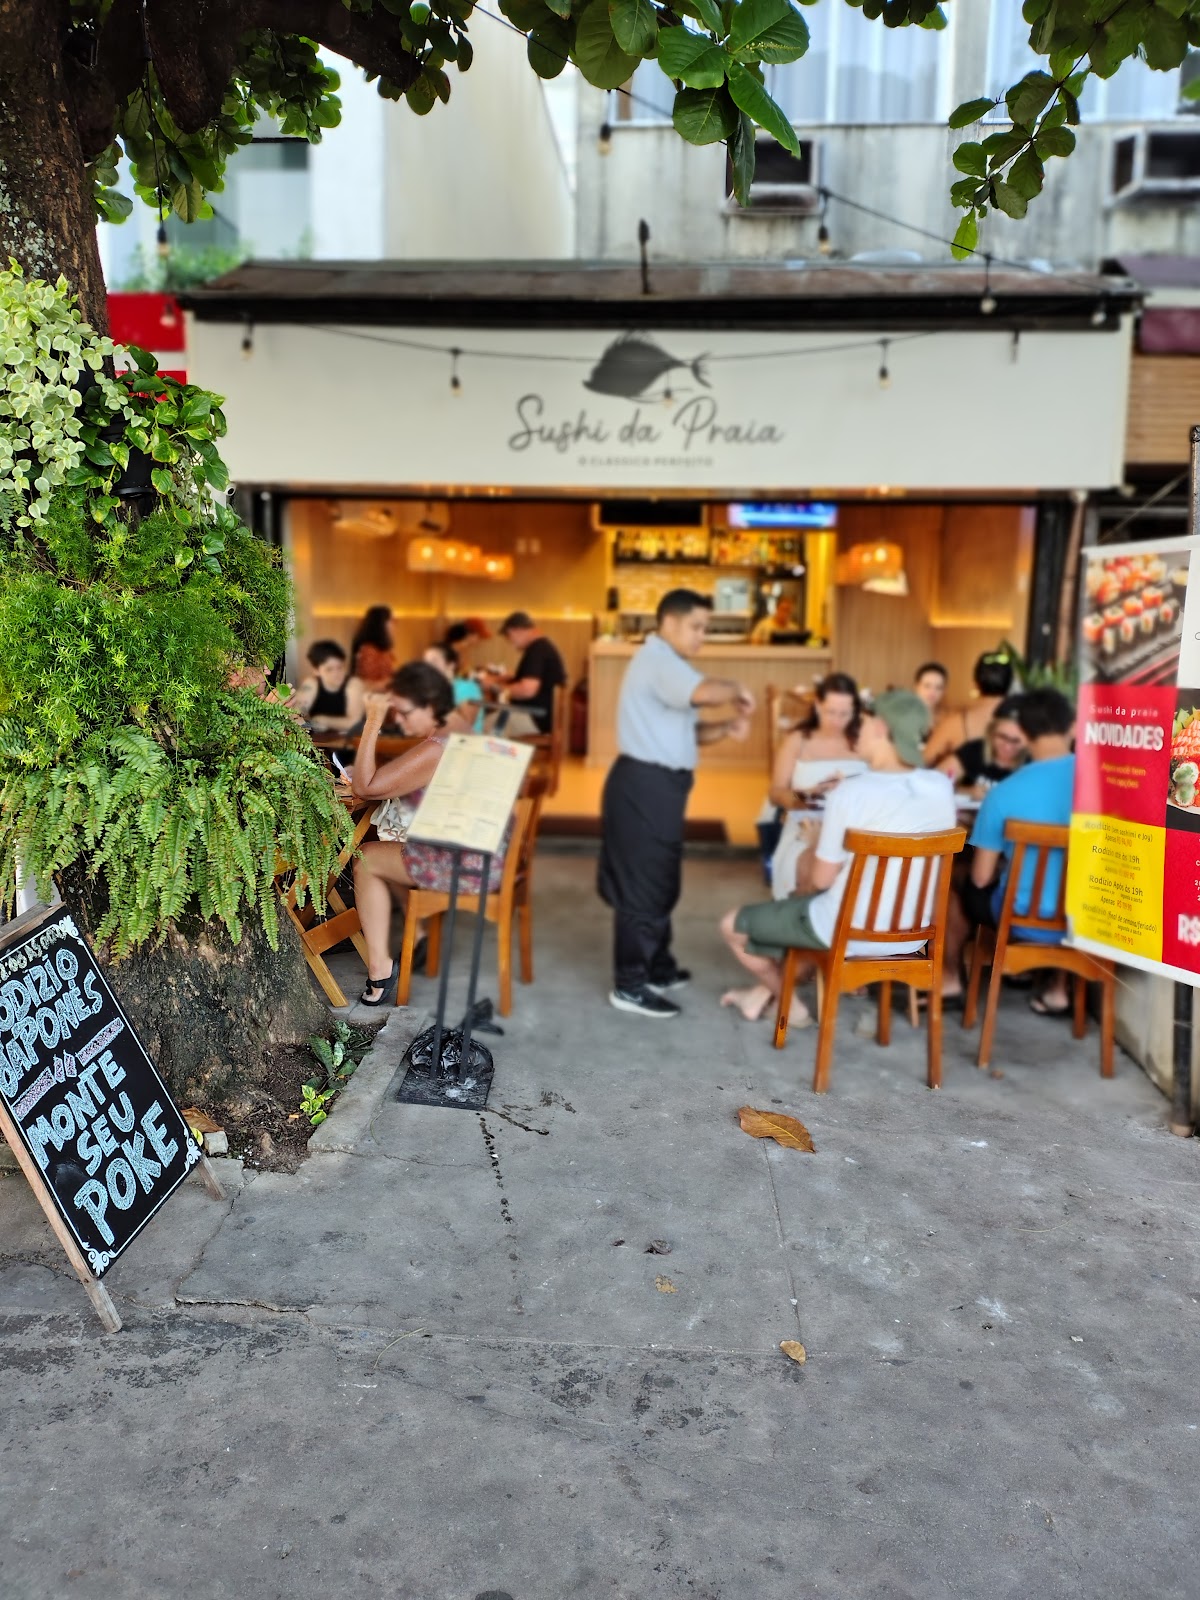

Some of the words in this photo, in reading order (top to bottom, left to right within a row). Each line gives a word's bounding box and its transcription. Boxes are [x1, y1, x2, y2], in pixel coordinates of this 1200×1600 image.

[509, 394, 609, 453] Sushi
[618, 408, 662, 447] da
[672, 395, 785, 451] Praia
[1089, 704, 1113, 715] Sushi
[1115, 705, 1126, 716] da
[1130, 708, 1159, 718] praia
[1085, 721, 1164, 751] NOVIDADES
[1129, 855, 1140, 864] 19h
[1100, 895, 1115, 906] Apenas
[1131, 887, 1144, 897] 19h
[26, 1050, 127, 1171] MONTE
[77, 1091, 135, 1176] SEU
[73, 1100, 179, 1246] POKE
